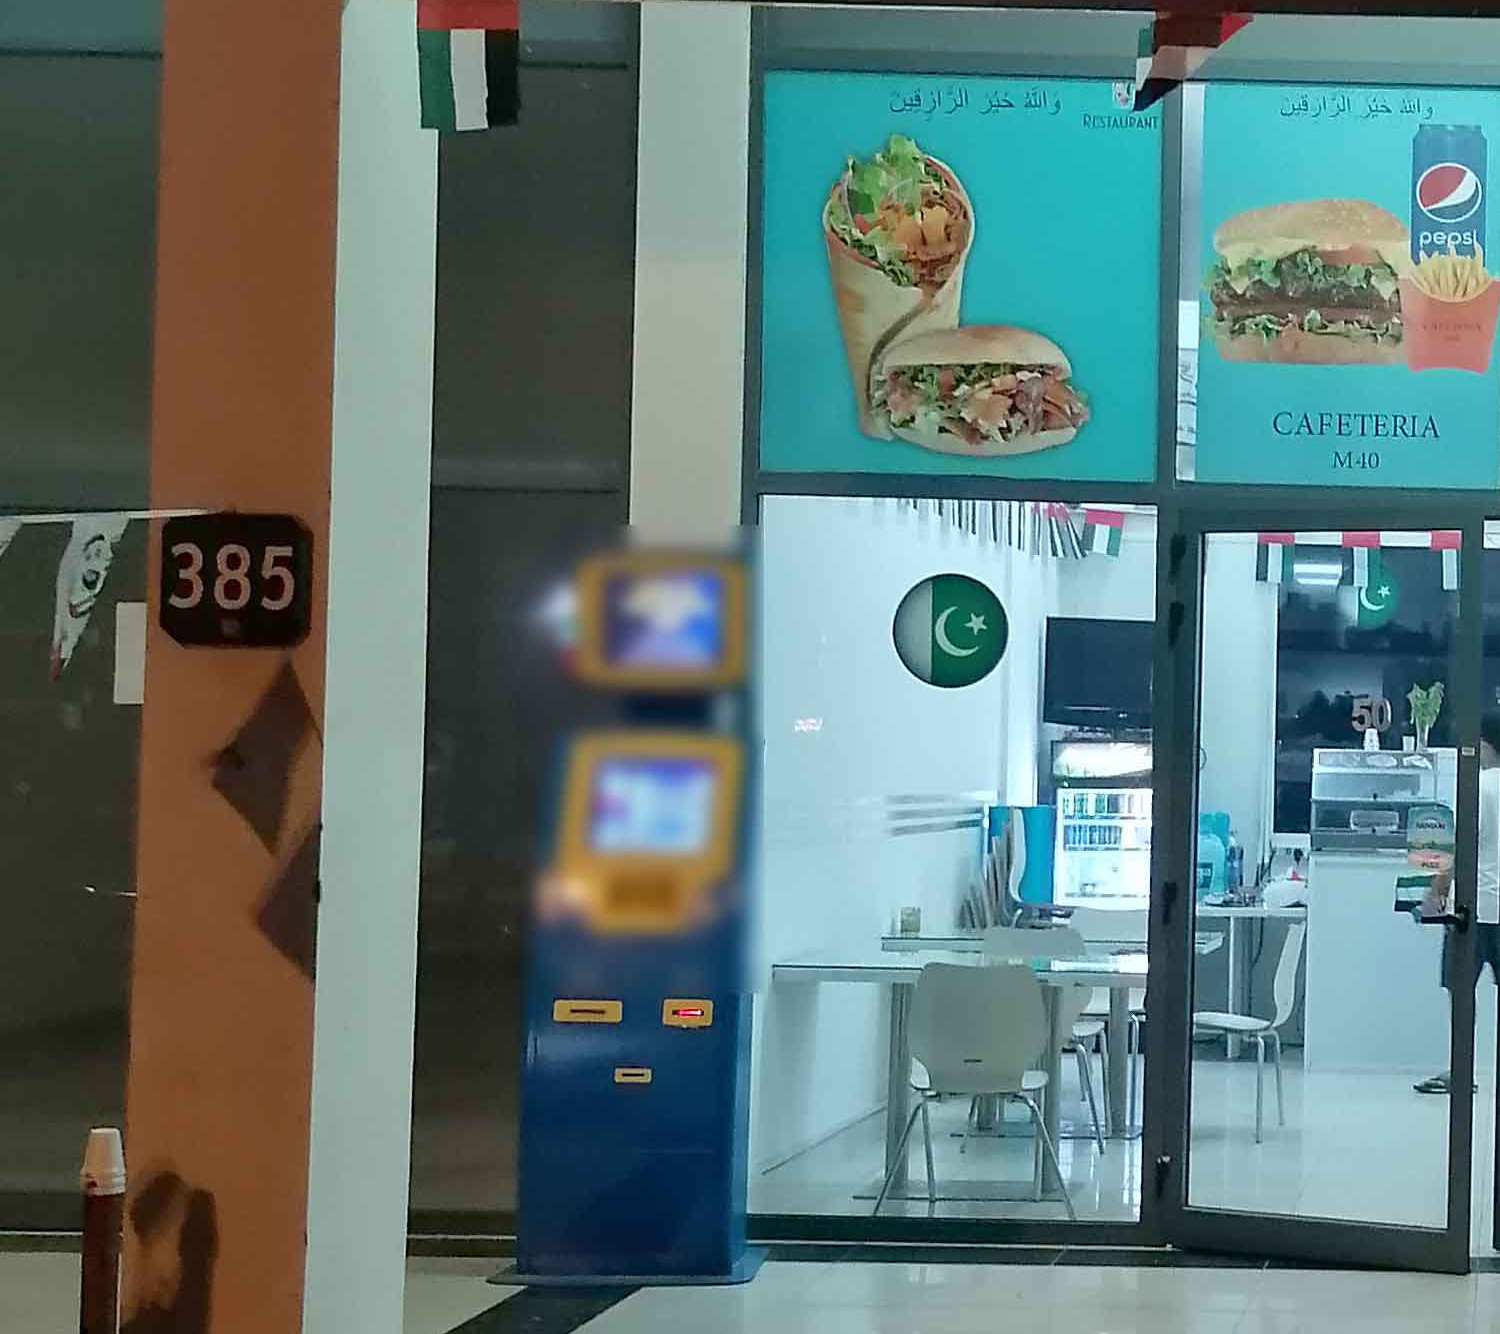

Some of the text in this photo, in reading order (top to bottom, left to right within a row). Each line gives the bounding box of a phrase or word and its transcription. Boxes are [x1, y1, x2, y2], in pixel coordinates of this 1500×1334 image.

[1420, 229, 1477, 249] pepsi
[1272, 411, 1441, 439] CAFETERIA
[168, 542, 296, 611] 385
[1351, 698, 1392, 732] 50
